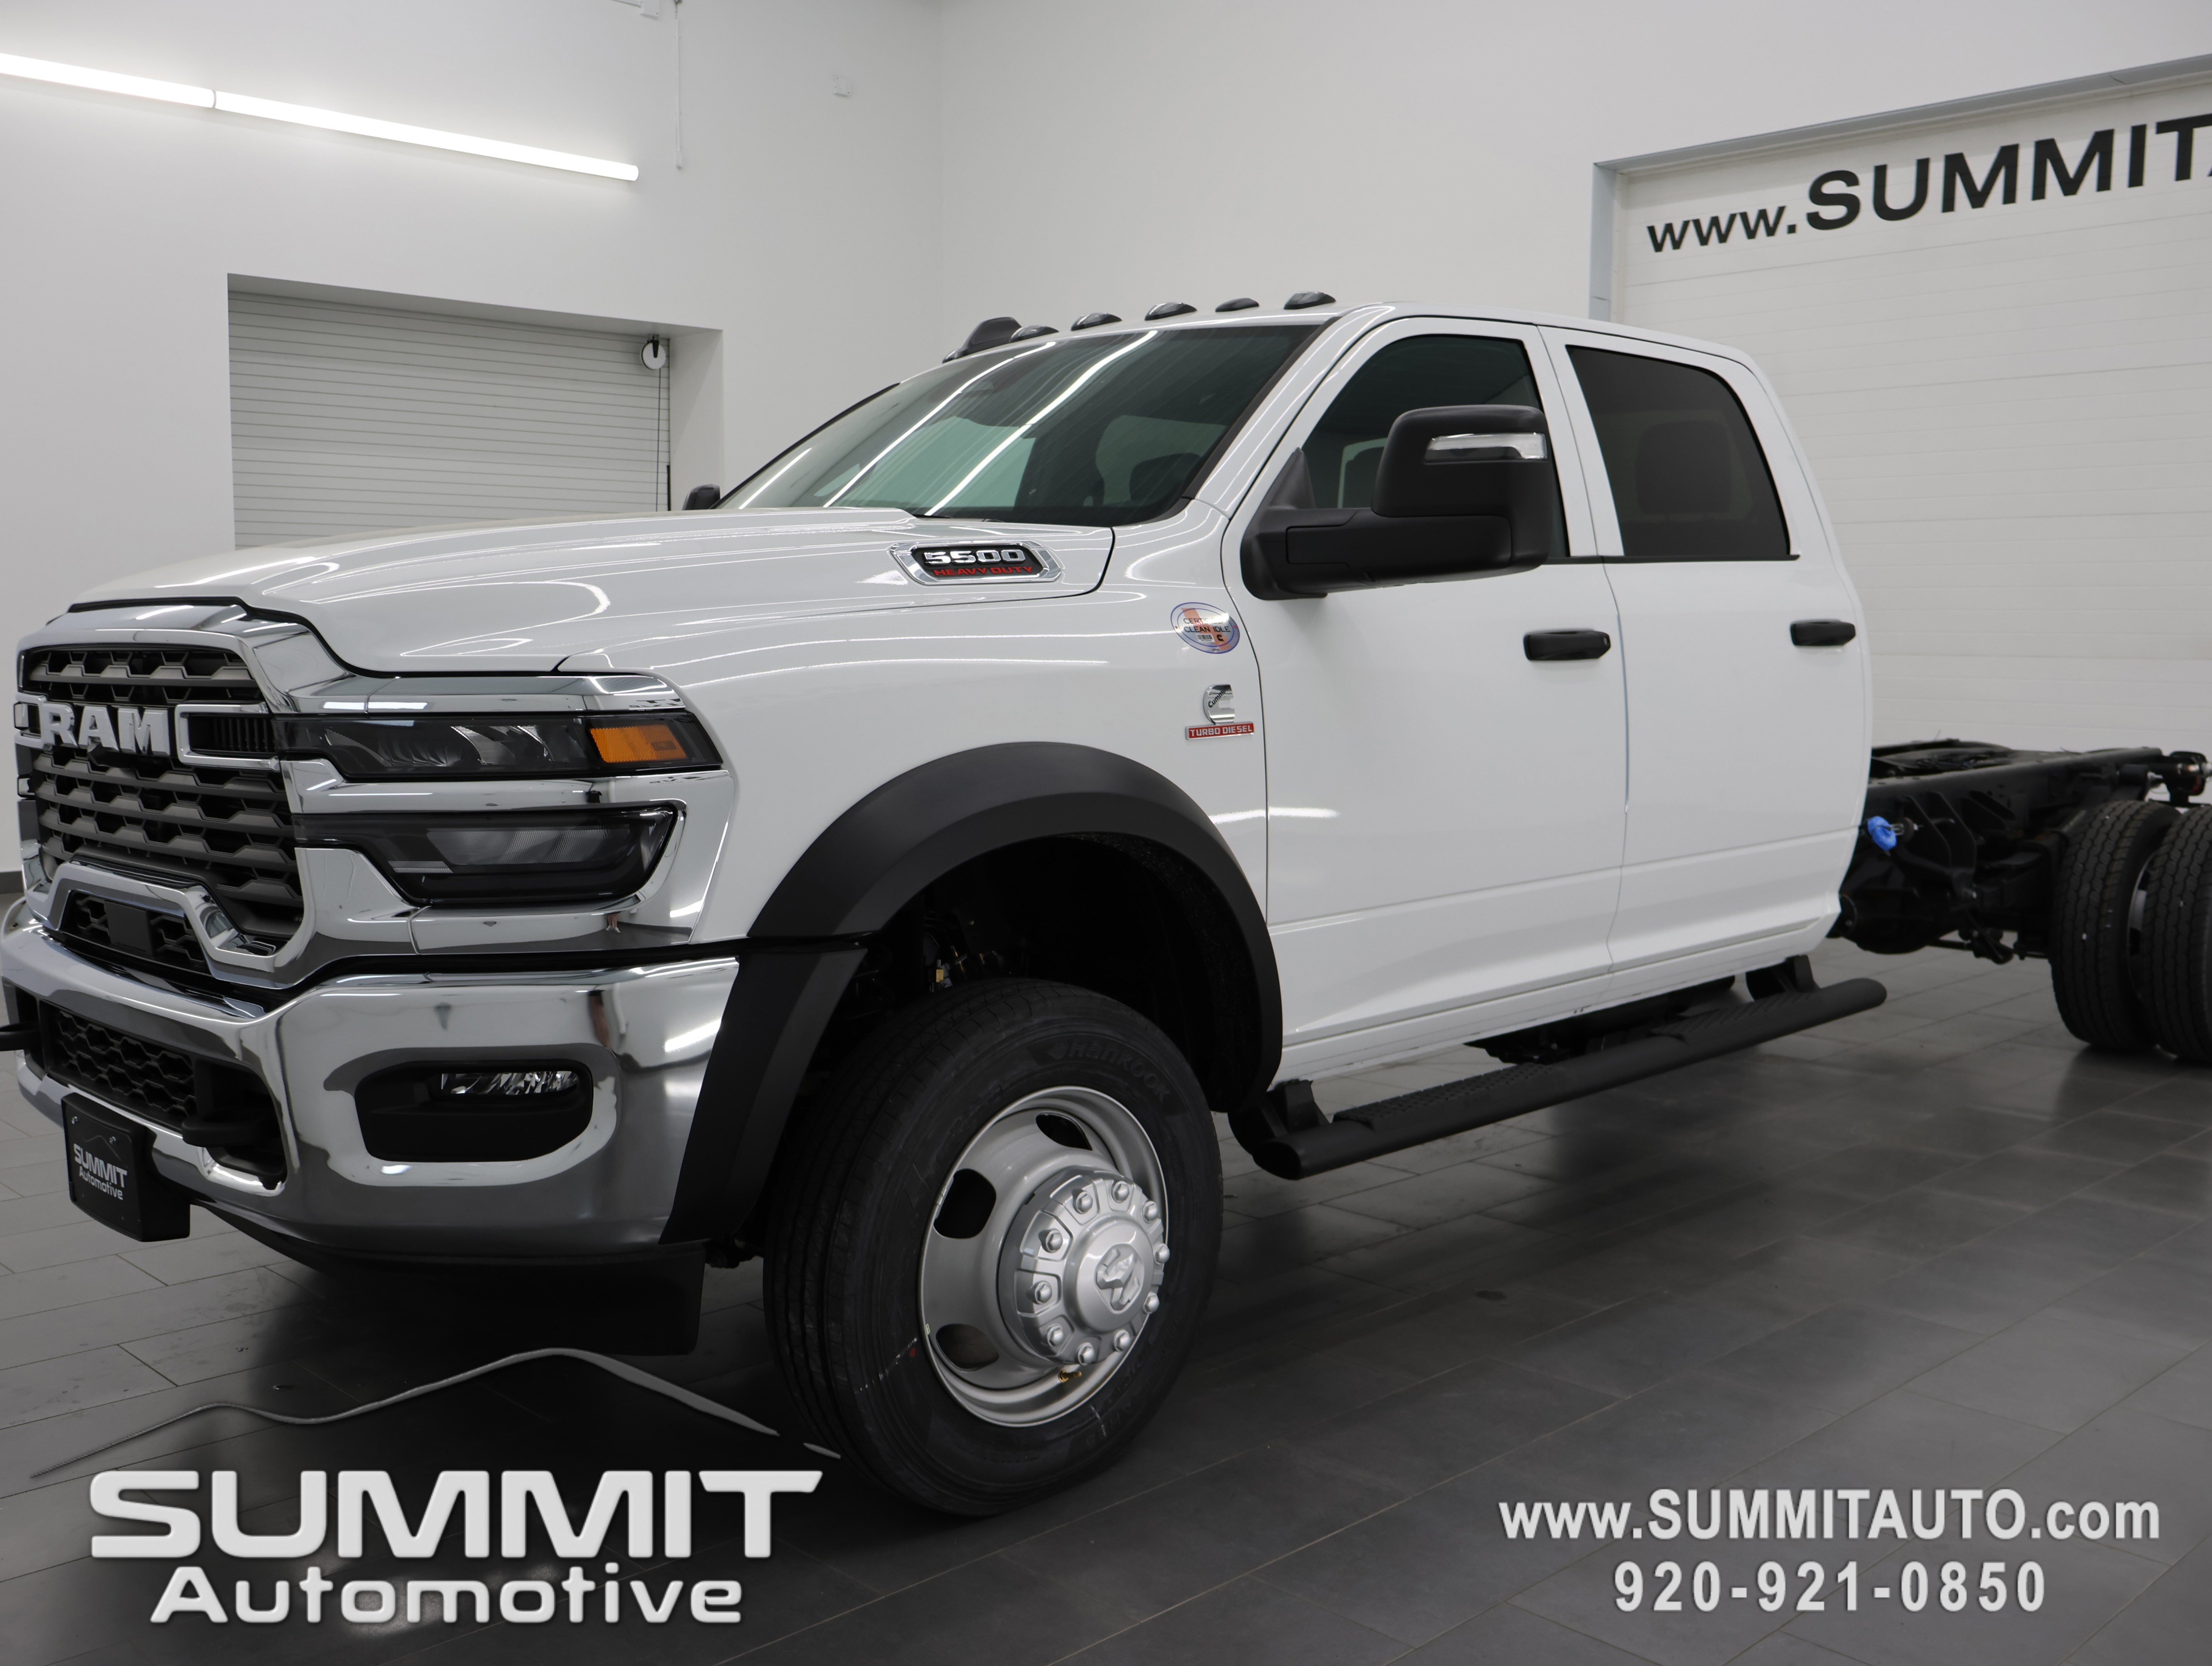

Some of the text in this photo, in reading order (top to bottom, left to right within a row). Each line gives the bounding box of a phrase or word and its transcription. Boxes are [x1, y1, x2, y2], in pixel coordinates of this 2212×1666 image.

[1647, 113, 2212, 252] www.SUMMIT
[923, 550, 1026, 565] 5500
[933, 566, 1033, 576] HEAVY DUTY
[1208, 685, 1230, 708] Cummin
[40, 700, 170, 757] RAM
[1190, 725, 1252, 737] TURBO DIESEL
[73, 1143, 128, 1188] SUMMIT
[79, 1165, 123, 1201] Automotive
